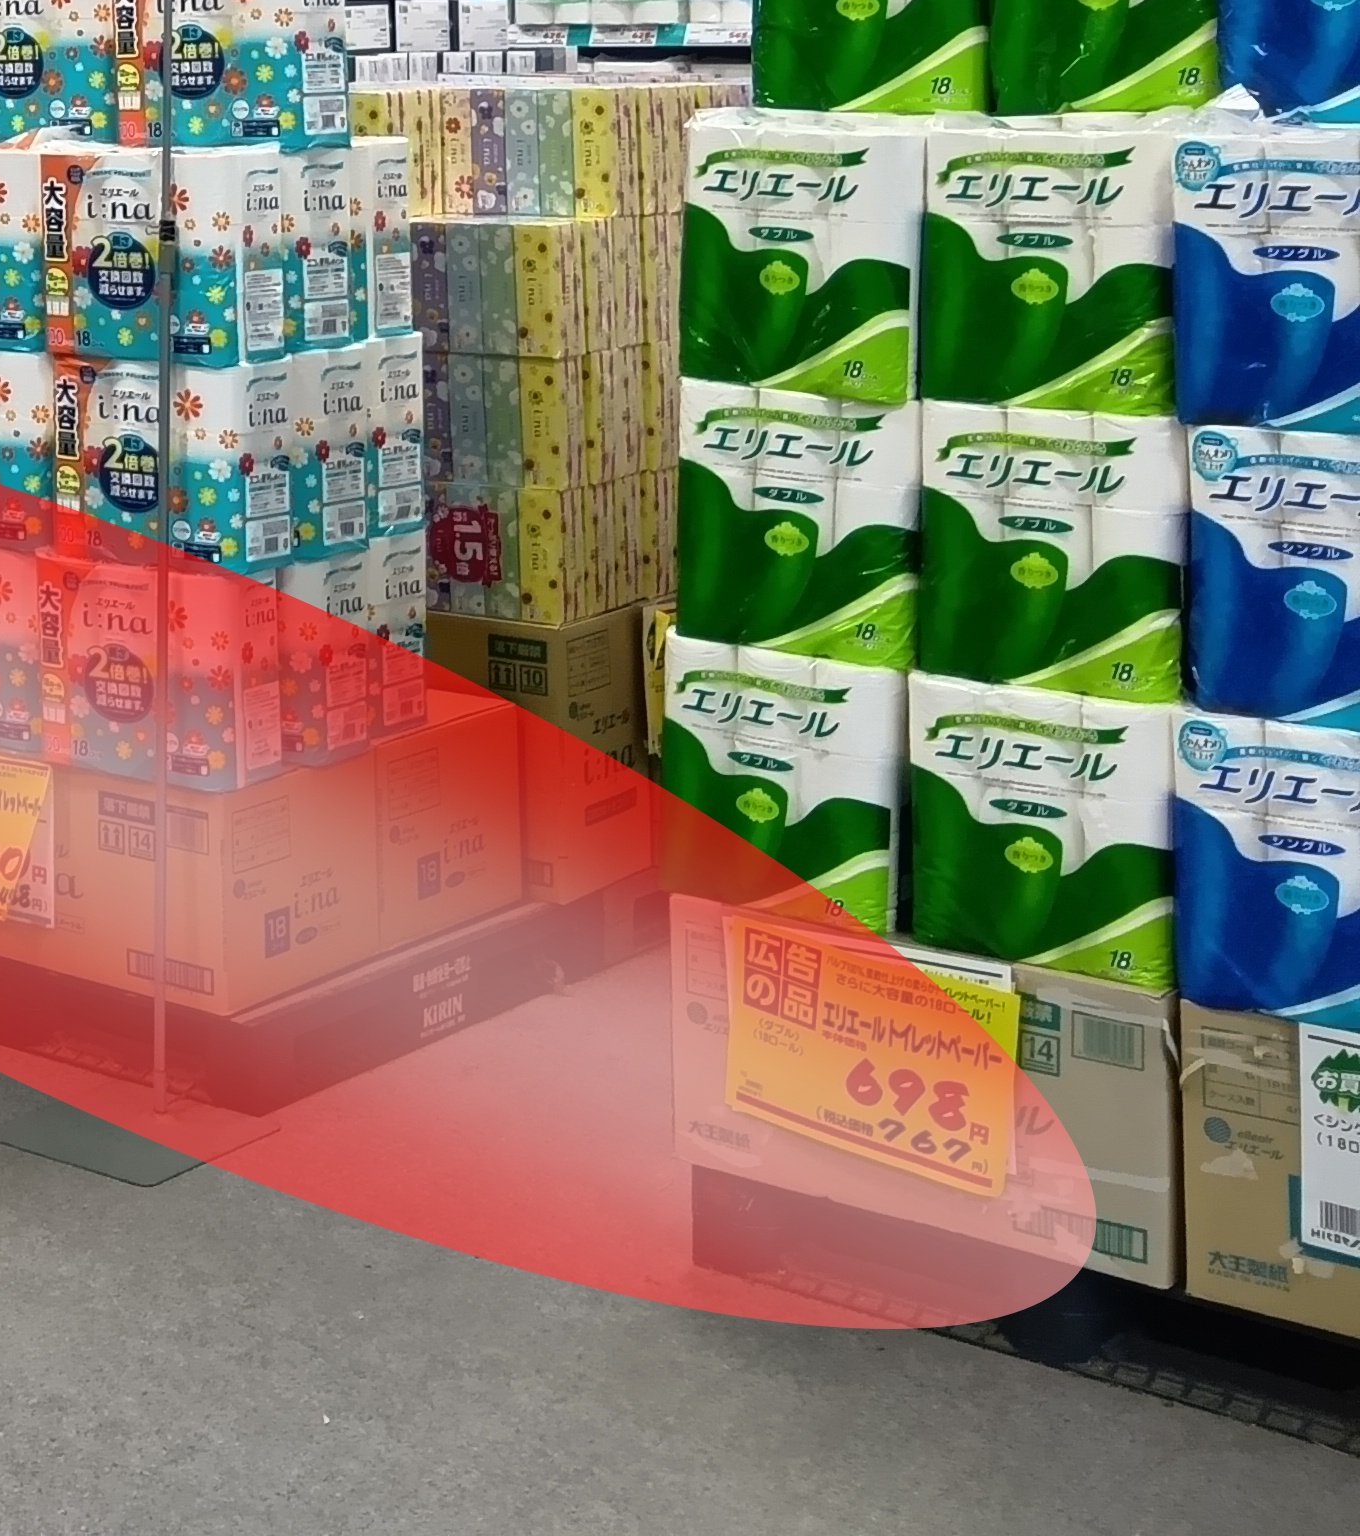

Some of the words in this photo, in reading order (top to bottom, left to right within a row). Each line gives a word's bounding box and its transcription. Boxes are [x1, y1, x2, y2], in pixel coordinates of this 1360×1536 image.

[930, 75, 951, 96] 18
[703, 168, 860, 204] エリエール
[945, 170, 1126, 208] エリエール
[43, 178, 68, 260] 大容量
[764, 228, 799, 241] ダブル
[1267, 246, 1327, 261] シングル
[703, 425, 875, 467] エリエール
[945, 452, 1127, 495] エリエール
[1281, 543, 1341, 559] シングル
[681, 686, 842, 739] エリエール
[935, 733, 1118, 782] エリエール
[131, 829, 153, 851] 14
[1108, 949, 1133, 970] 18
[423, 993, 464, 1028] KIRIN
[1025, 1037, 1053, 1062] 14
